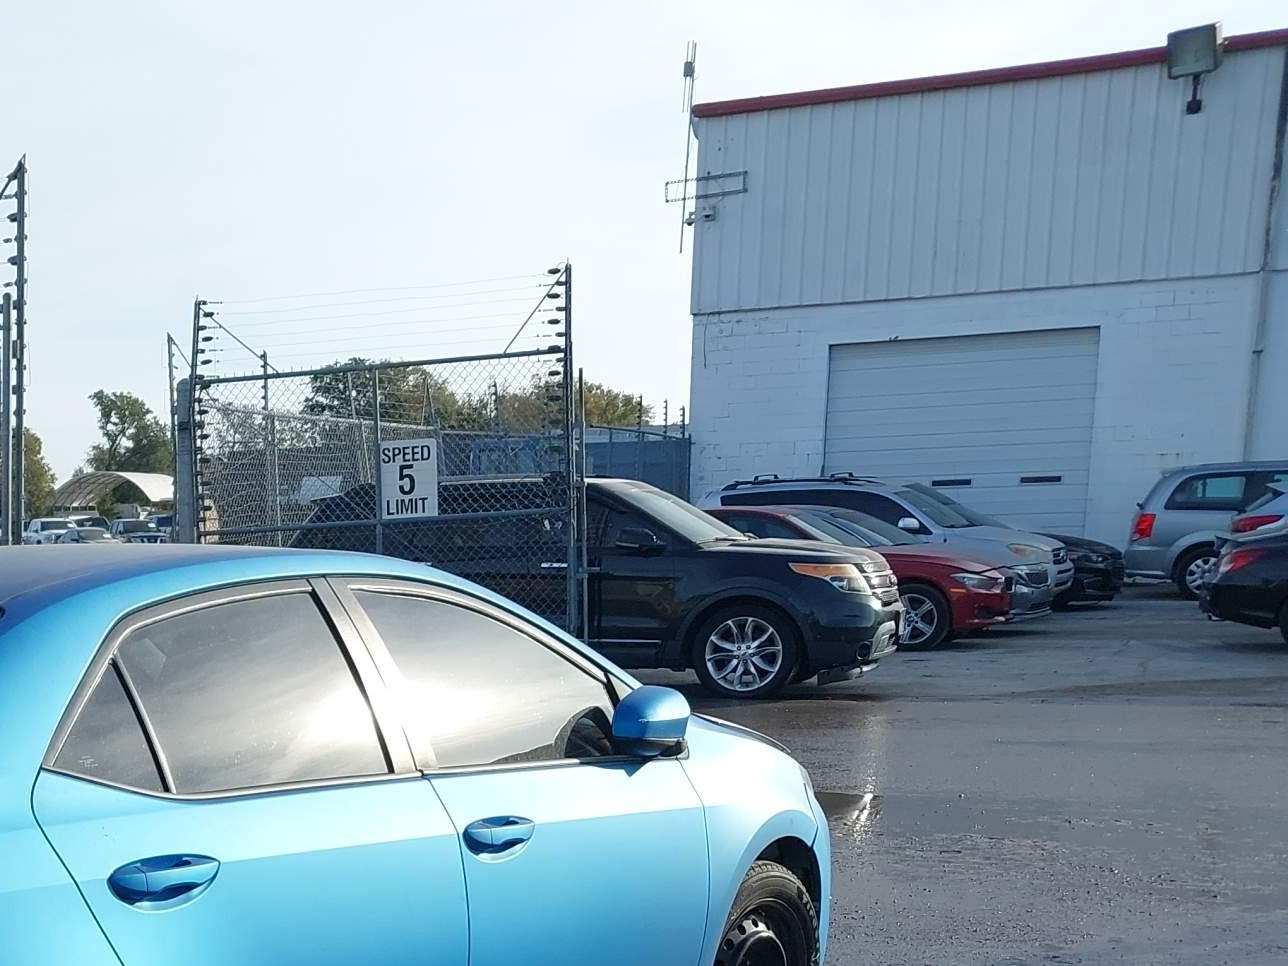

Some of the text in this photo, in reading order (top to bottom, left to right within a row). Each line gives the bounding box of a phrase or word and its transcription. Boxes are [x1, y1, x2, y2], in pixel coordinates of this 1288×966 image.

[382, 445, 431, 464] SPEED
[398, 464, 416, 496] 5
[386, 497, 428, 516] LIMIT
